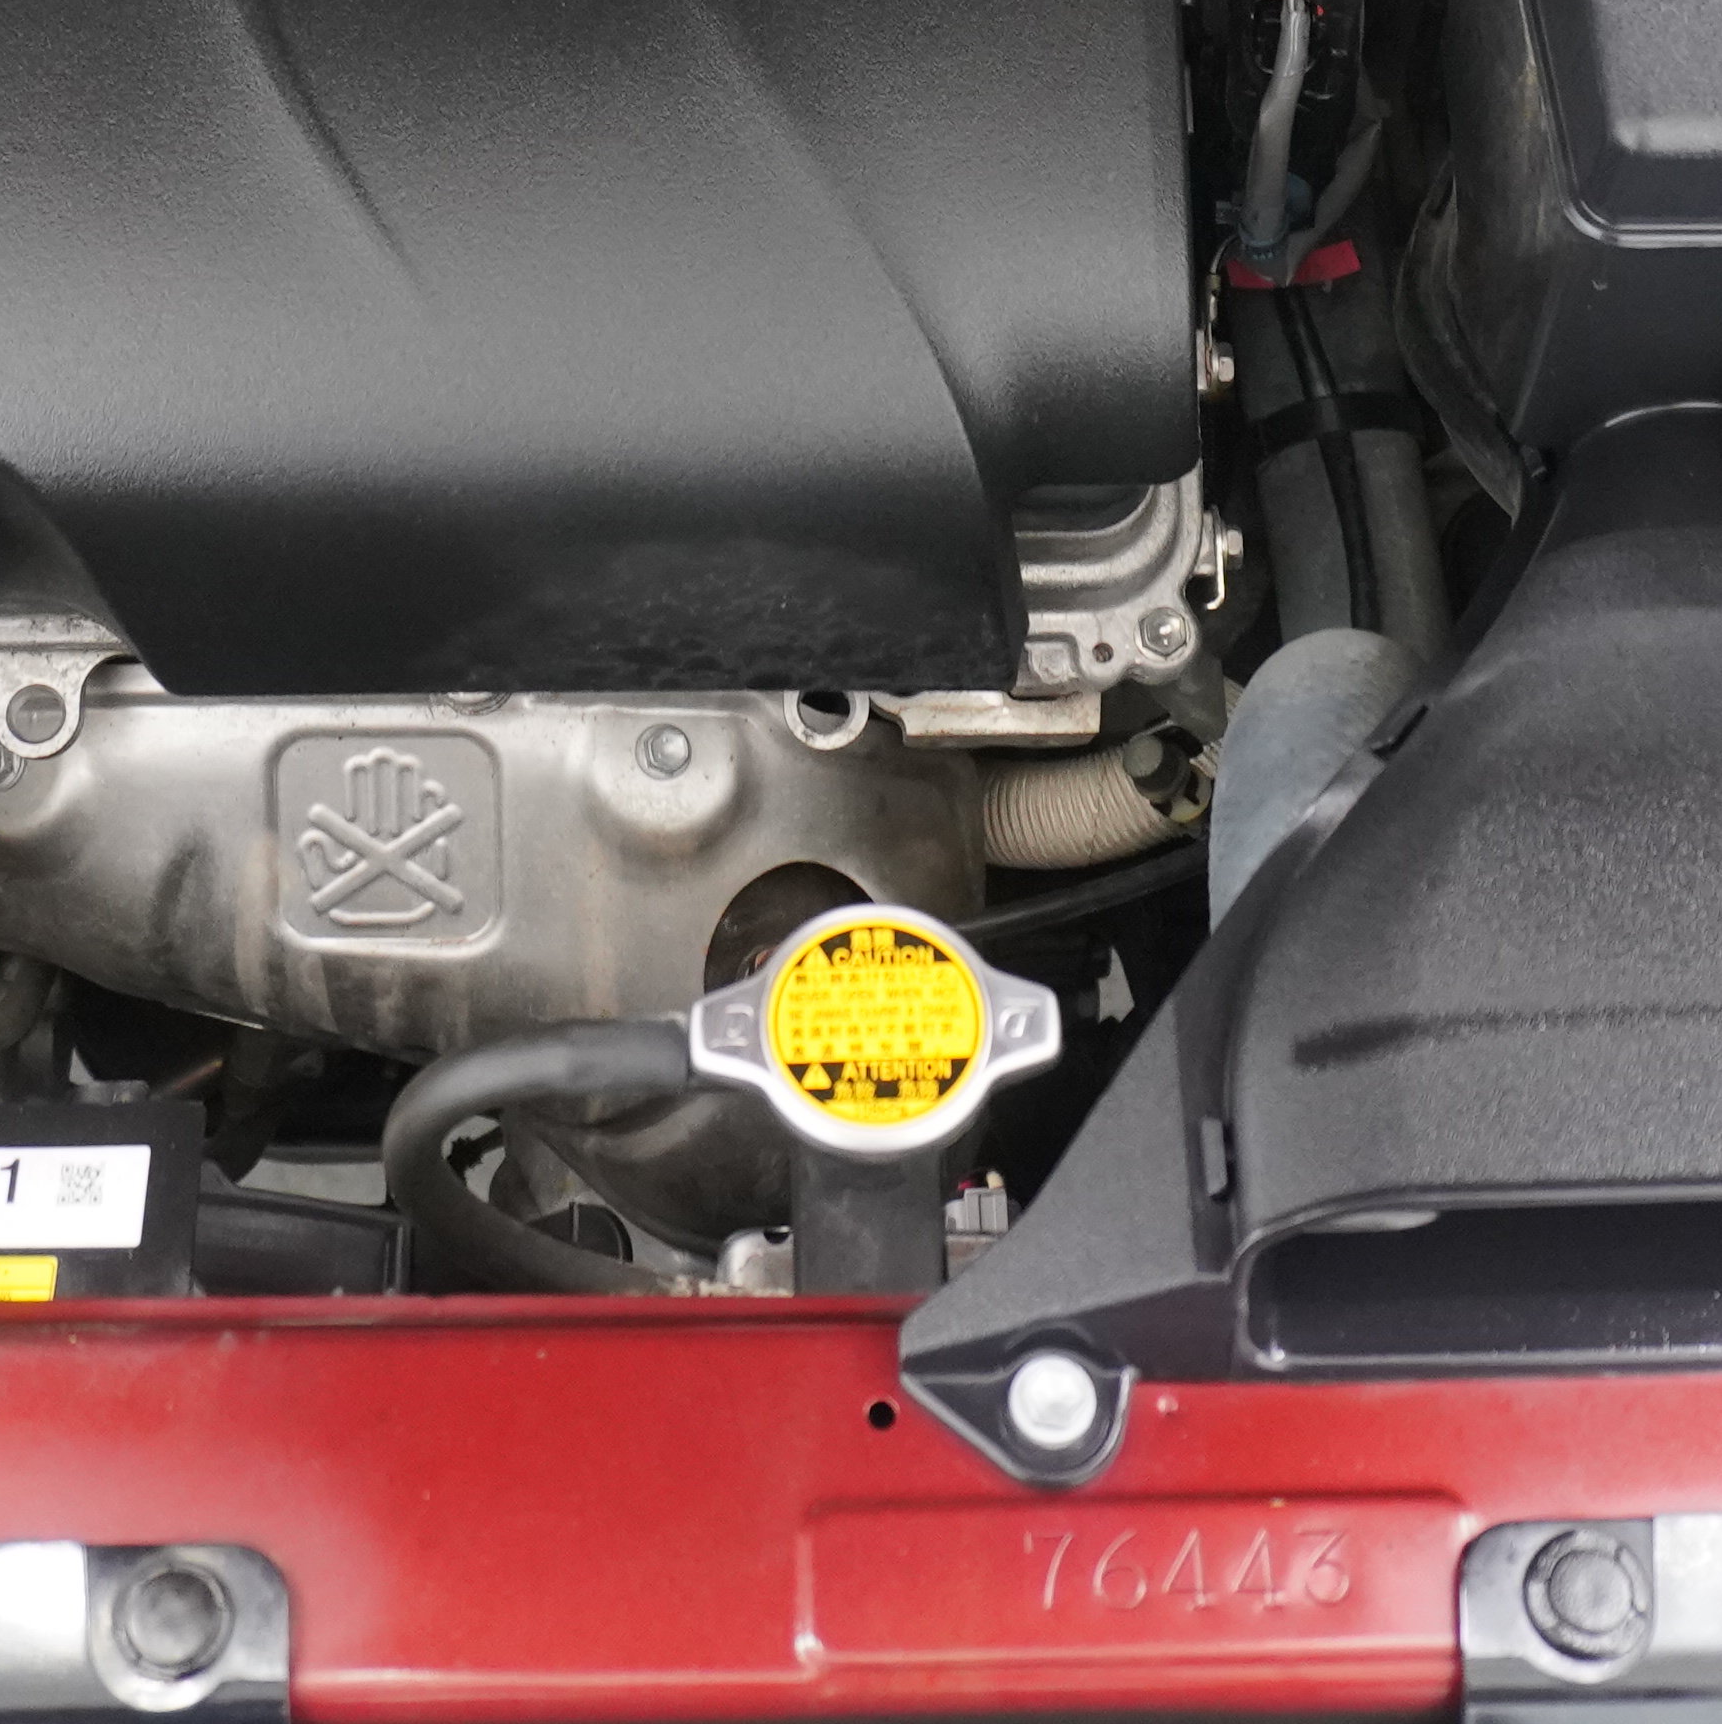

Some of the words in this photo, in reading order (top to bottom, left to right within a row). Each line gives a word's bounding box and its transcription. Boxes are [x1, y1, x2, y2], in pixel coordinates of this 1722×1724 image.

[831, 945, 935, 968] CAUTION
[841, 1058, 953, 1081] ATTENTION
[1022, 1526, 1353, 1612] 76443
